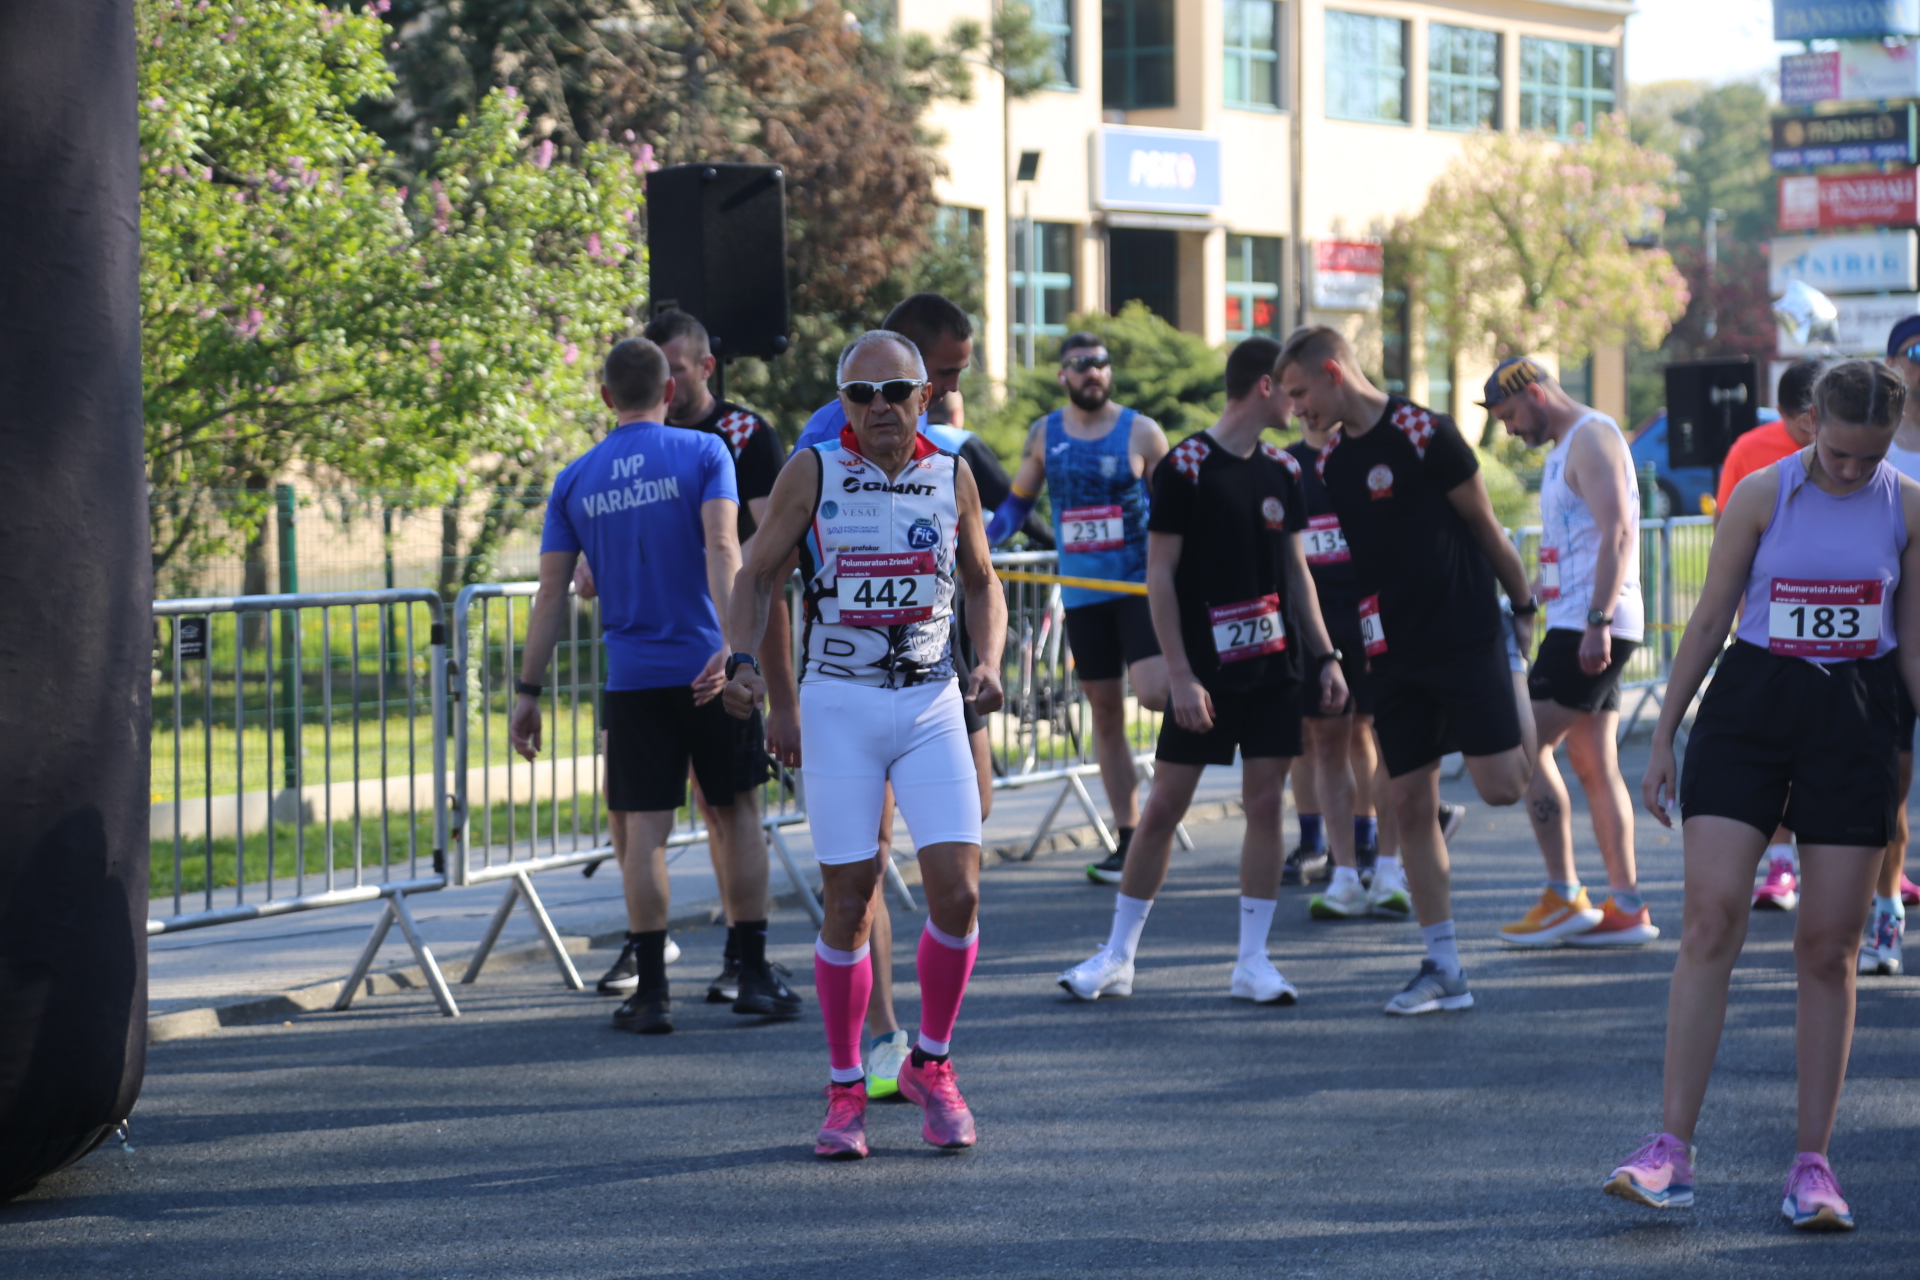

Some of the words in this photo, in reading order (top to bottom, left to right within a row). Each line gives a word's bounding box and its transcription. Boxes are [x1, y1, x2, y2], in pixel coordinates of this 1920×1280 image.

[610, 453, 645, 480] JVP
[582, 476, 680, 518] VARAŽDIN
[862, 481, 937, 496] GIANT
[842, 508, 880, 517] VESAL
[912, 527, 933, 545] fit
[1072, 522, 1110, 541] 231
[841, 558, 888, 568] Polumaraton
[853, 577, 918, 608] 442
[1775, 583, 1828, 594] Polumaraton
[1789, 606, 1860, 638] 183
[1227, 617, 1273, 647] 279
